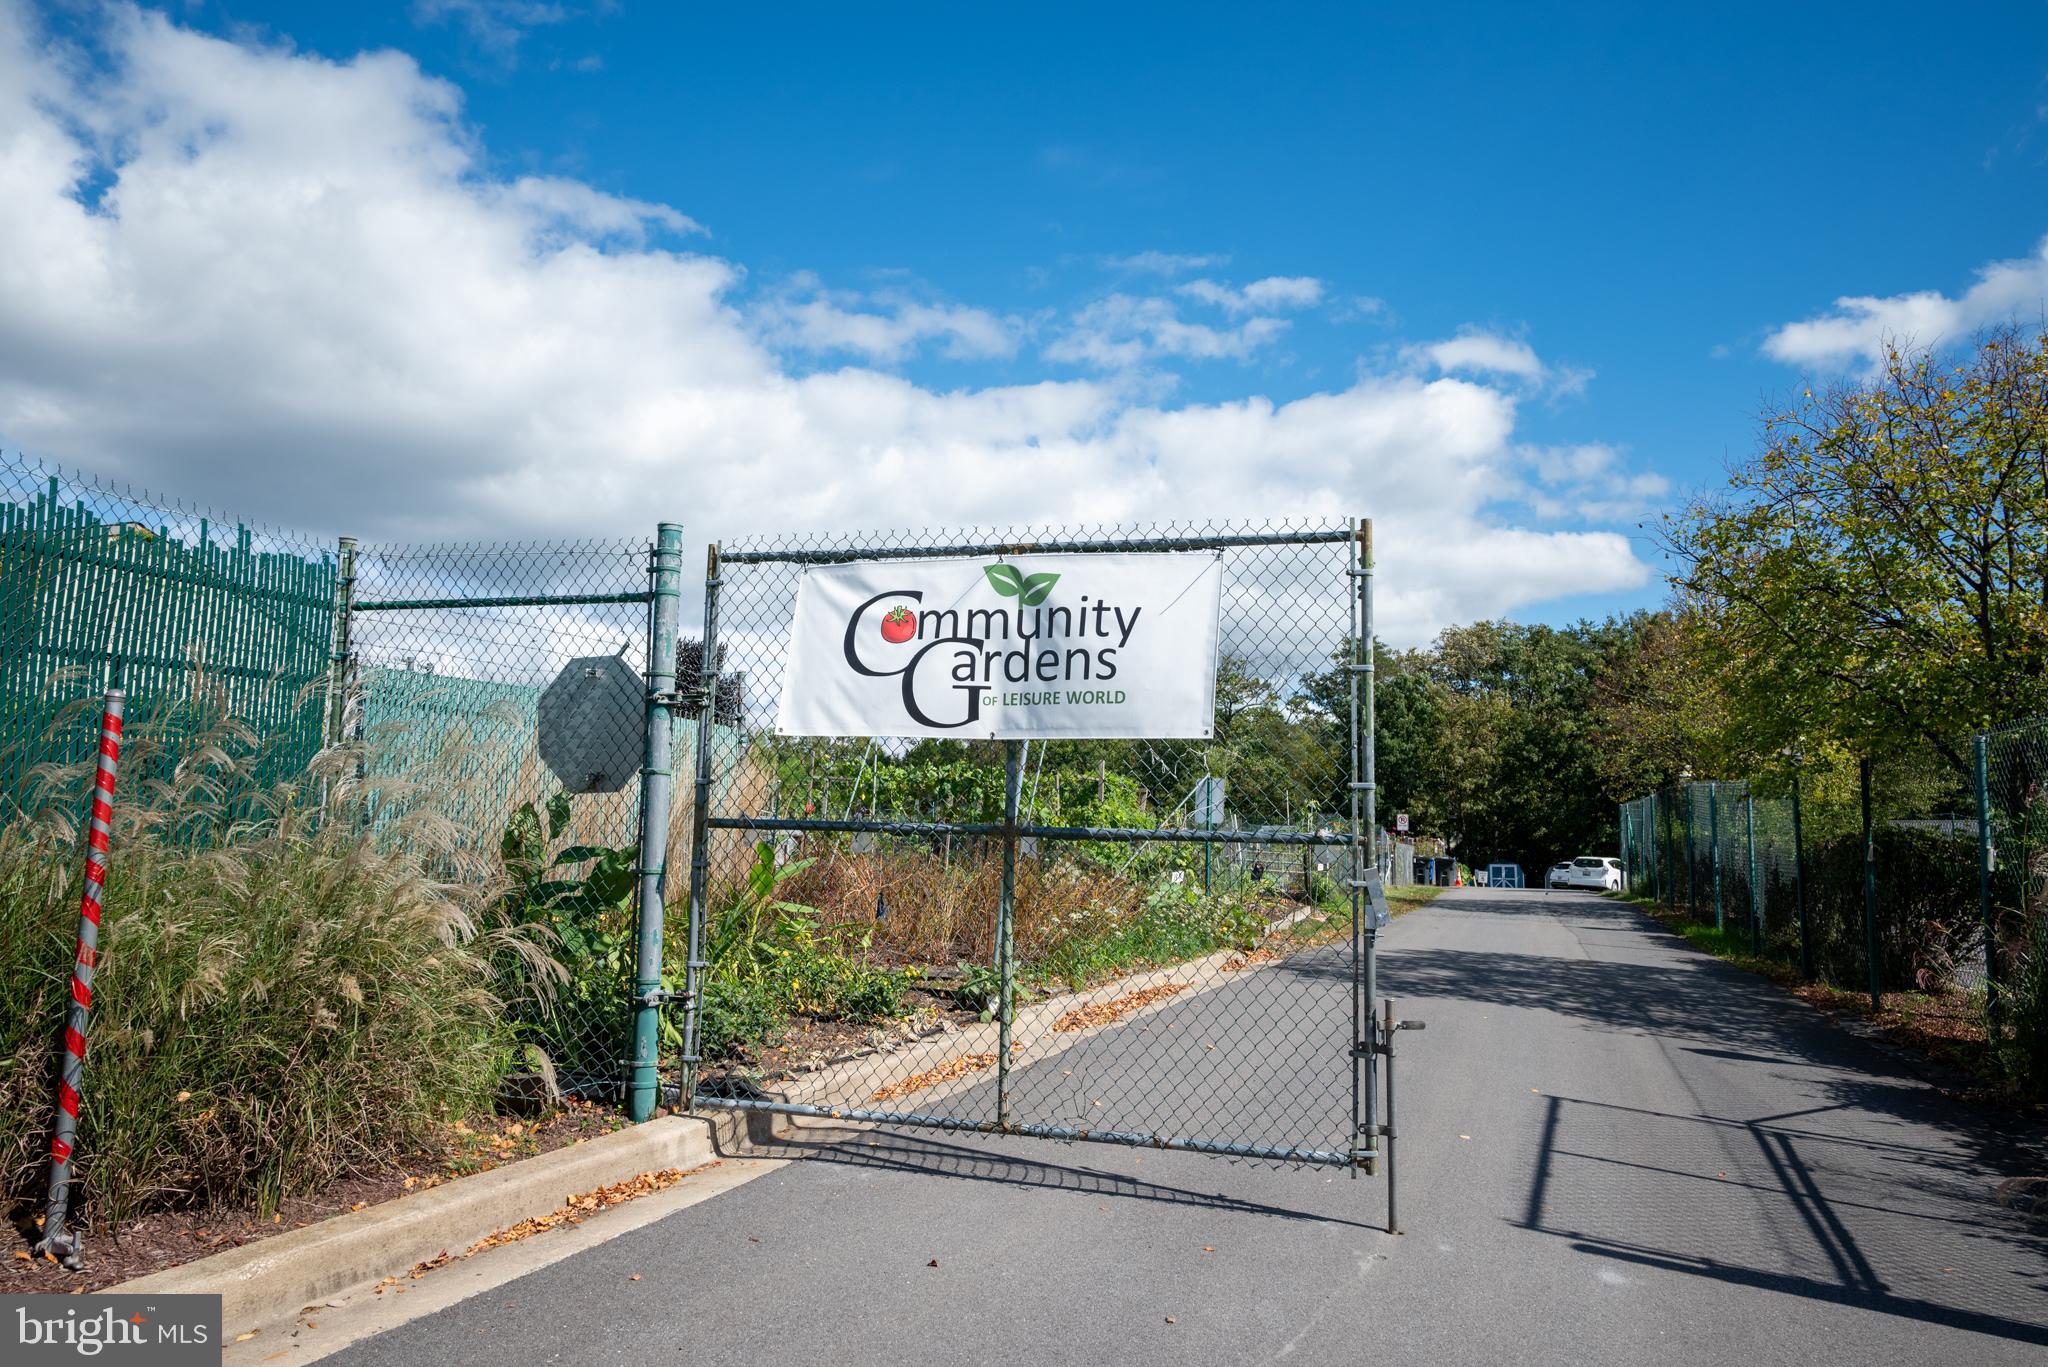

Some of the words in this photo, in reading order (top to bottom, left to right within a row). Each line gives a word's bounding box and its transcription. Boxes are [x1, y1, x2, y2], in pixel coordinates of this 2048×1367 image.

[844, 590, 1142, 677] Community
[902, 637, 1117, 728] Gardens
[982, 696, 998, 706] OF
[1002, 691, 1061, 706] LEISURE
[1066, 690, 1126, 705] WORLD
